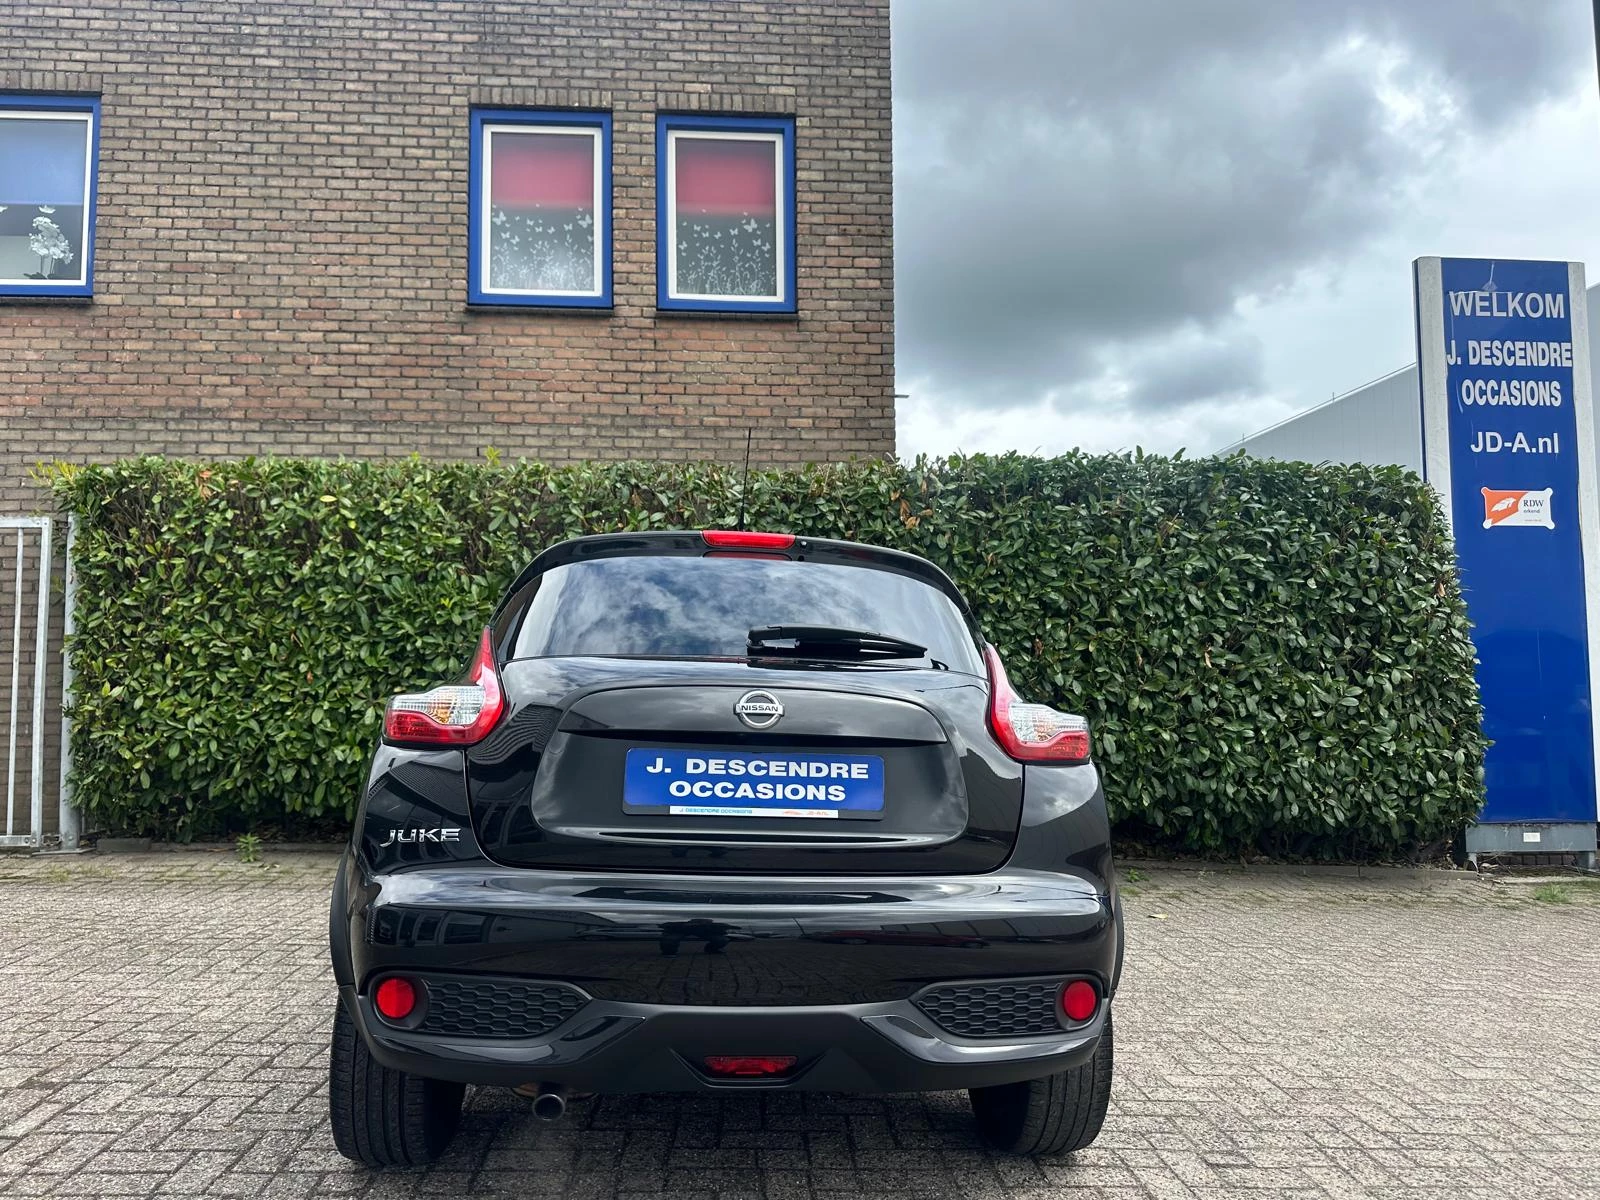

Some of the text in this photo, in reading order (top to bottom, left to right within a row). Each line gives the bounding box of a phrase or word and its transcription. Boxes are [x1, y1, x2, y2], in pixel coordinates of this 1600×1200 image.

[1449, 291, 1565, 319] WELKOM
[1447, 340, 1573, 367] J. DESCENDRE
[1461, 379, 1562, 407] OCCASIONS
[1470, 431, 1559, 454] JD-A.nl
[1523, 499, 1544, 507] RDW
[646, 757, 869, 779] J. DESCENDRE
[669, 780, 846, 801] OCCASIONS
[380, 828, 461, 848] JUKE
